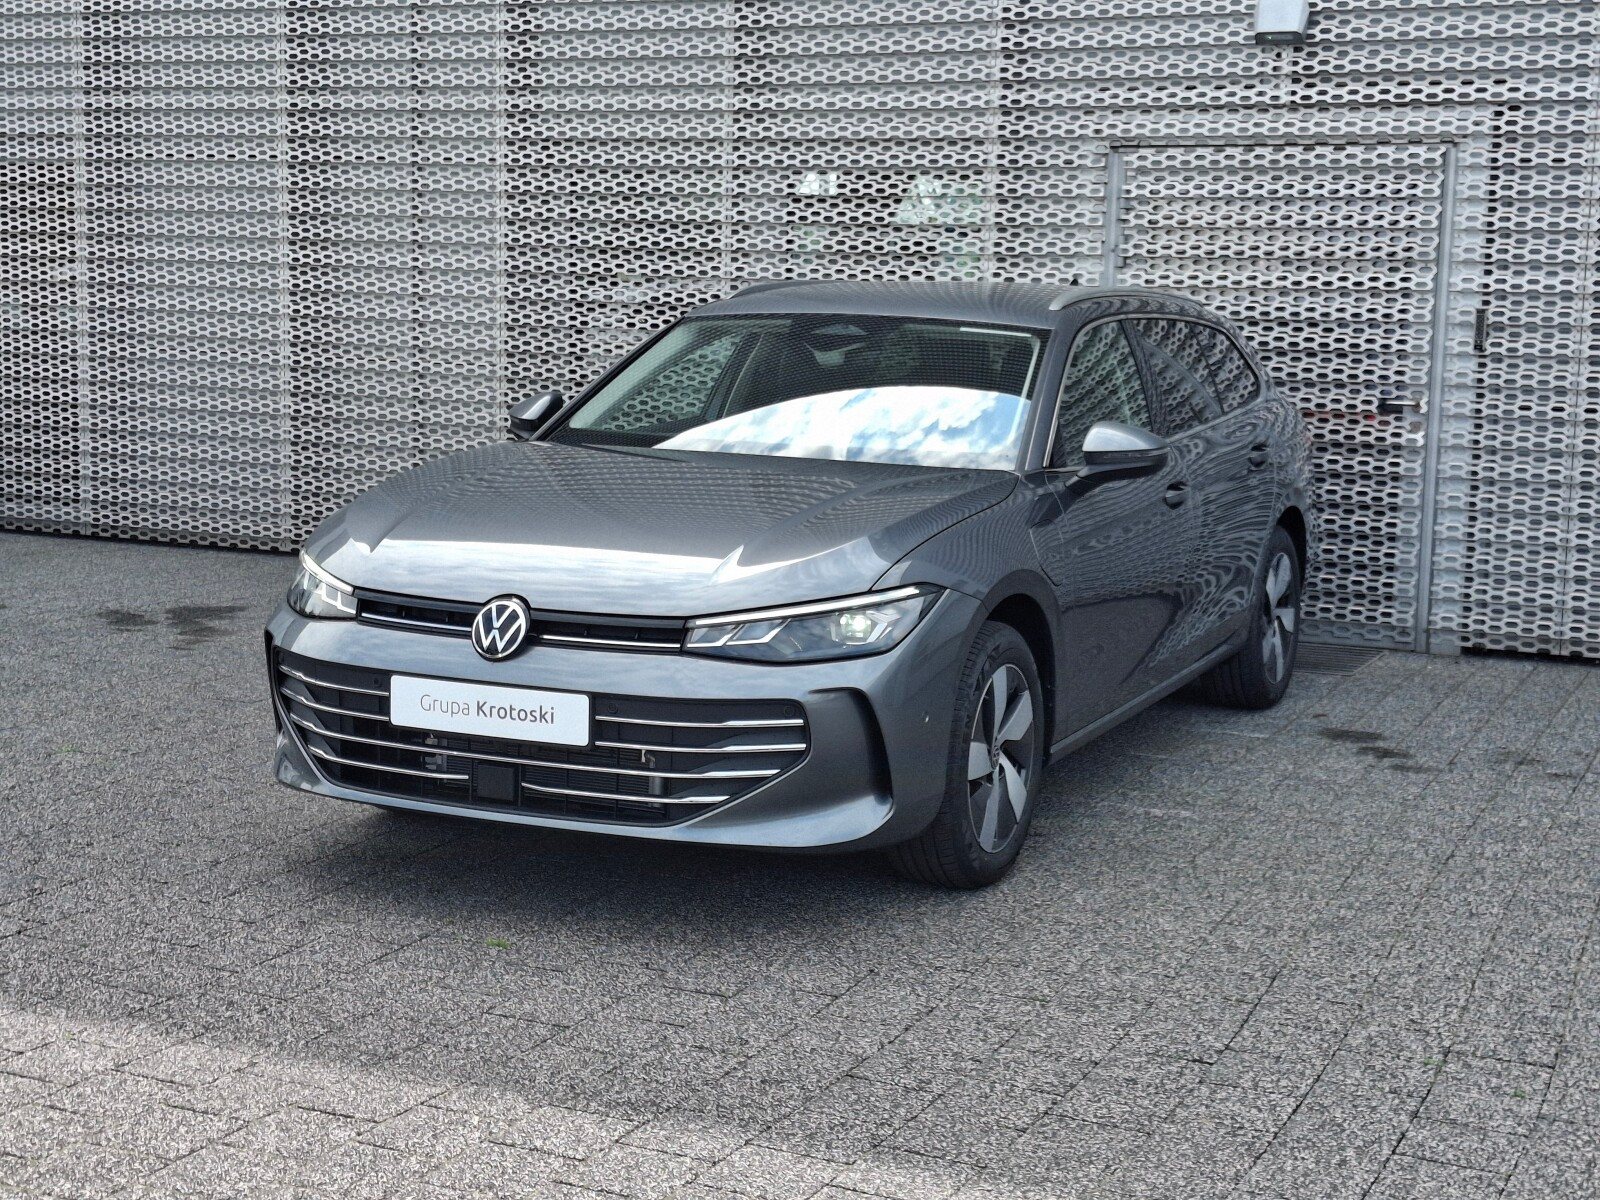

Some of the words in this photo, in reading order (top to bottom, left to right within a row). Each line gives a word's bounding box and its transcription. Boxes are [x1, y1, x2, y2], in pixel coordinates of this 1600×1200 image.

[472, 600, 526, 658] VW
[420, 694, 470, 717] Grupa
[476, 700, 555, 725] Krotoski
